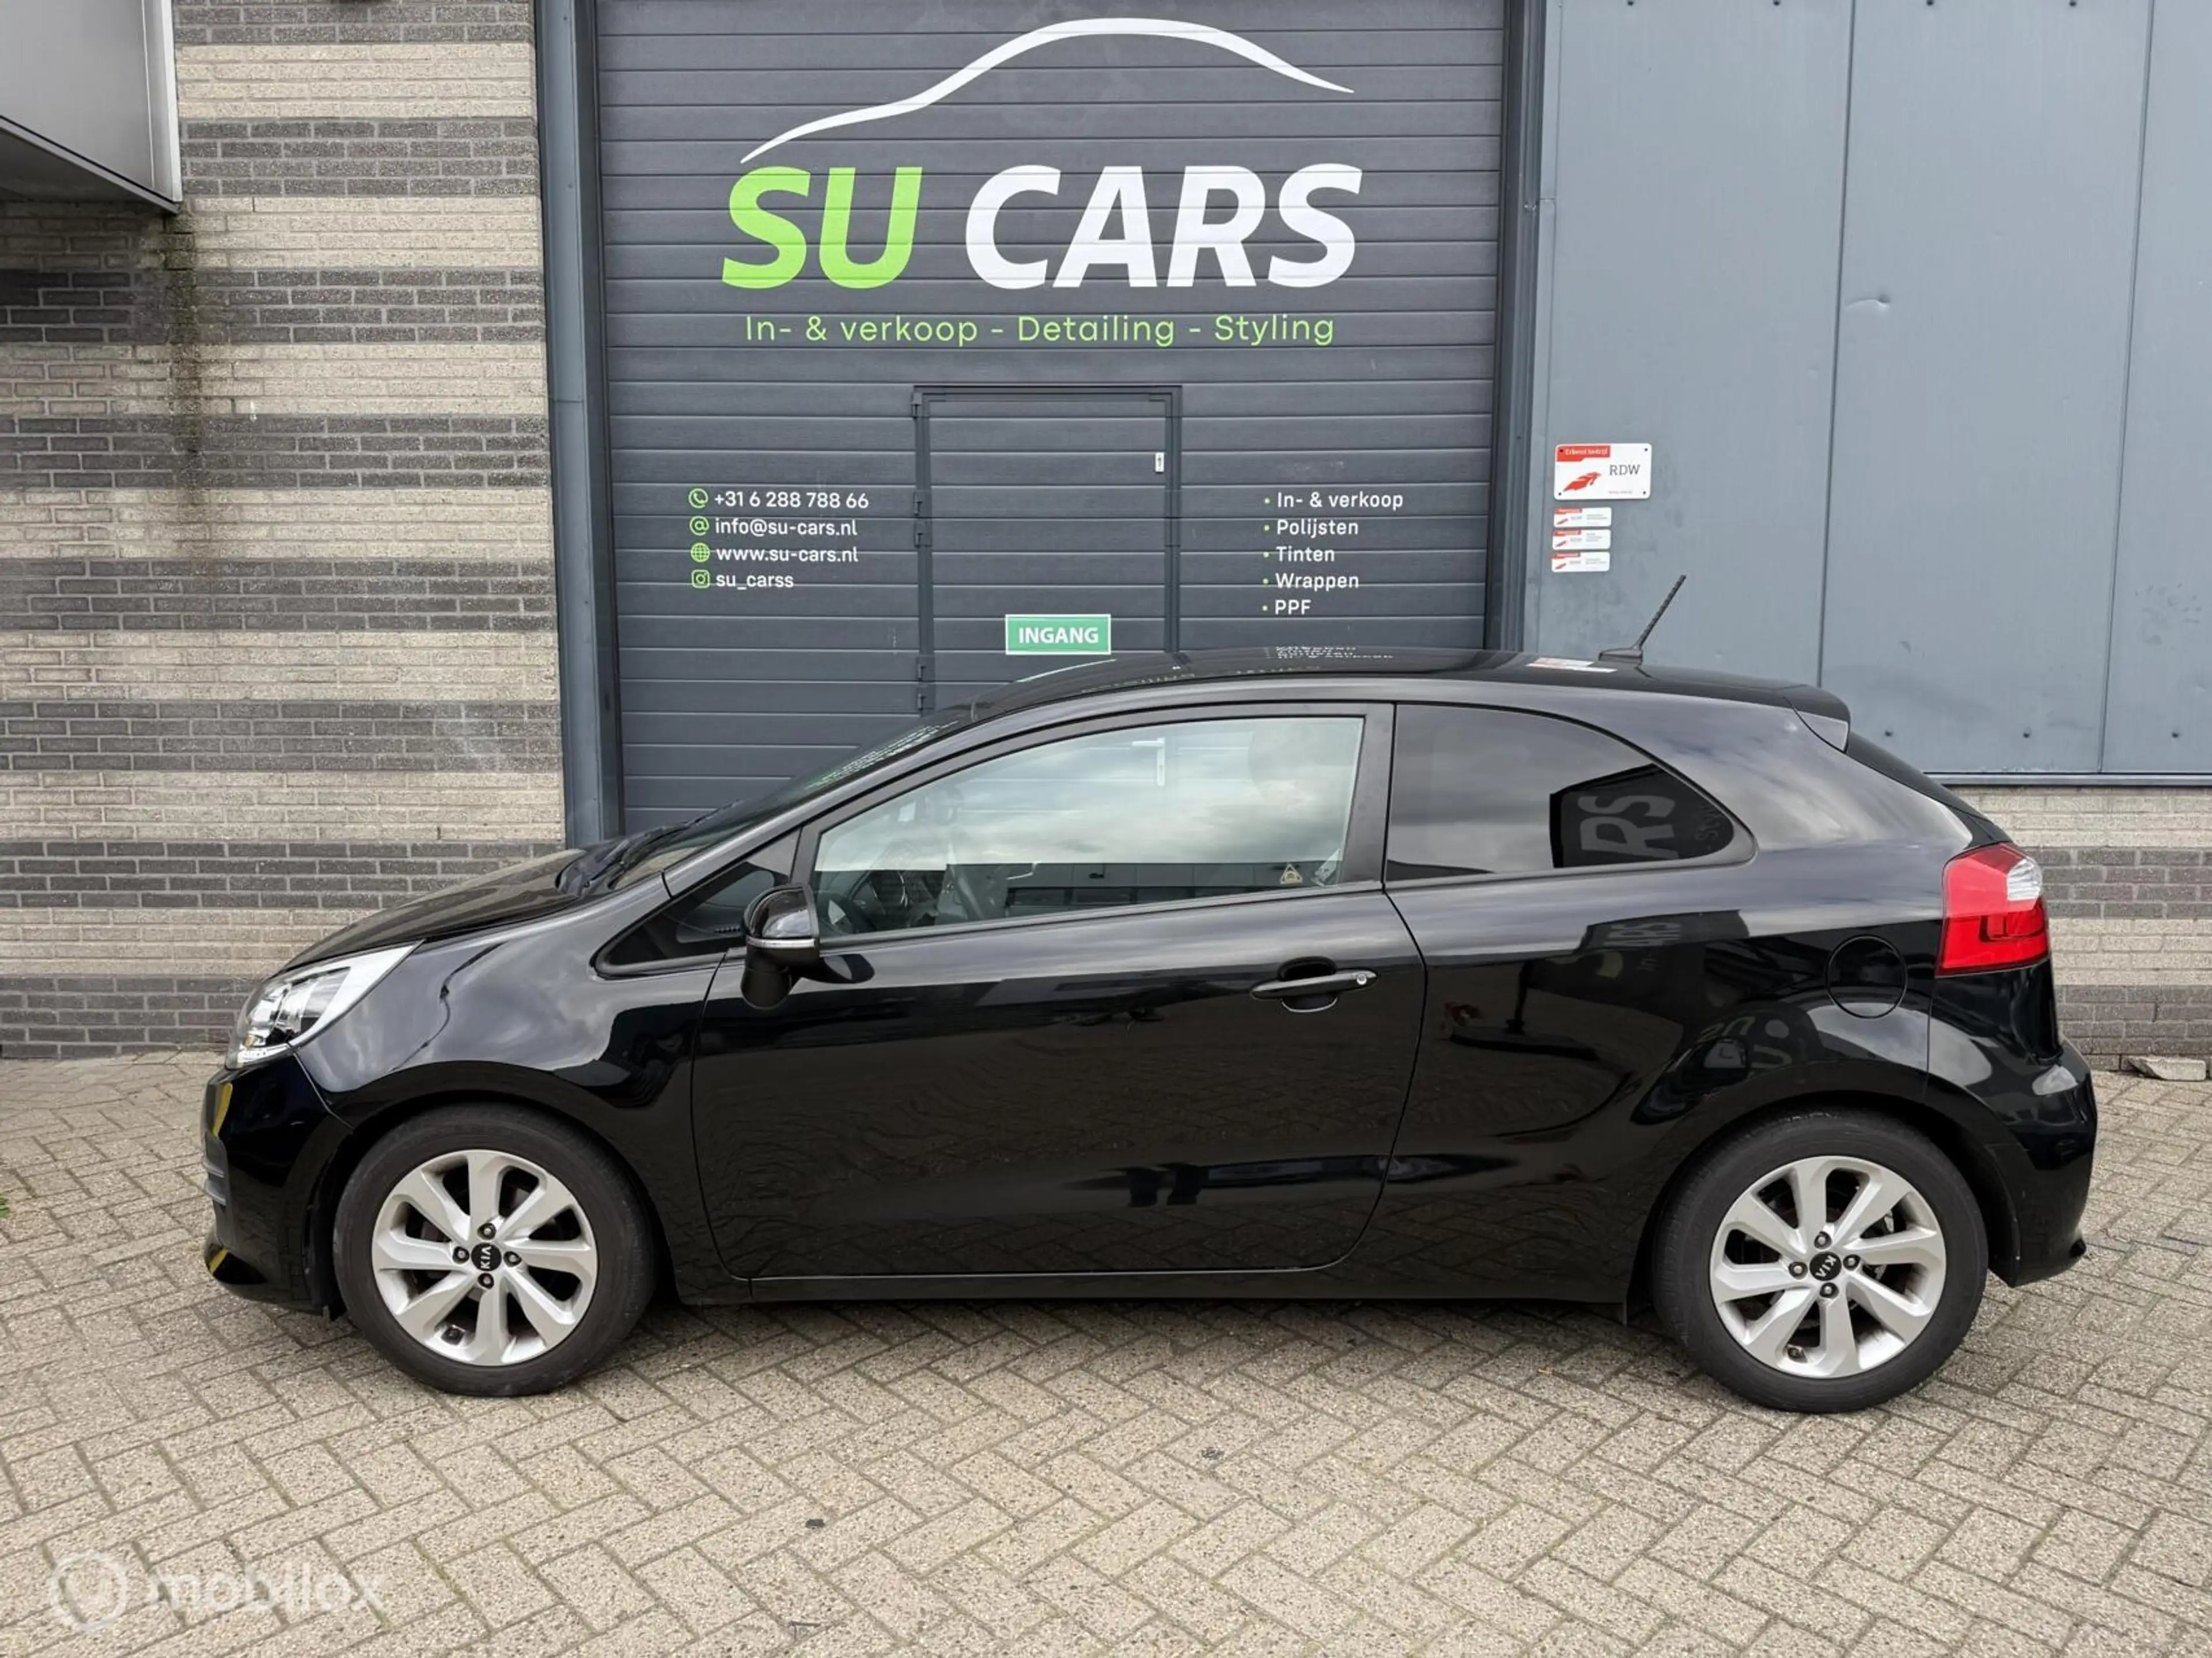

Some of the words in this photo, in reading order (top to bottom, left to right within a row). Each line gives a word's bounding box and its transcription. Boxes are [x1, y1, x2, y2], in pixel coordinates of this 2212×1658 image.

[722, 166, 923, 289] SU
[965, 163, 1362, 289] CARS
[746, 317, 791, 341] In-
[806, 317, 827, 342] &
[840, 316, 977, 347] verkoop
[1018, 316, 1174, 347] Detailing
[1215, 314, 1334, 346] Styling
[1609, 464, 1640, 476] RDW
[714, 491, 743, 506] +31
[749, 492, 760, 507] 6
[766, 492, 801, 507] 288
[806, 492, 840, 508] 788
[846, 493, 869, 508] 66
[1277, 492, 1303, 507] In-
[1310, 492, 1323, 507] &
[1329, 491, 1403, 510] verkoop
[715, 518, 858, 537] info@su-cars.nl
[1277, 518, 1358, 538] Polijsten
[717, 547, 858, 562] www.su-cars.nl
[1276, 546, 1335, 562] Tinten
[716, 573, 794, 590] su_carss
[1275, 573, 1359, 592] Wrappen
[1275, 600, 1311, 614] PPF
[1018, 627, 1099, 644] INGANG
[480, 1246, 492, 1269] KIA
[1816, 1255, 1837, 1277] KIA
